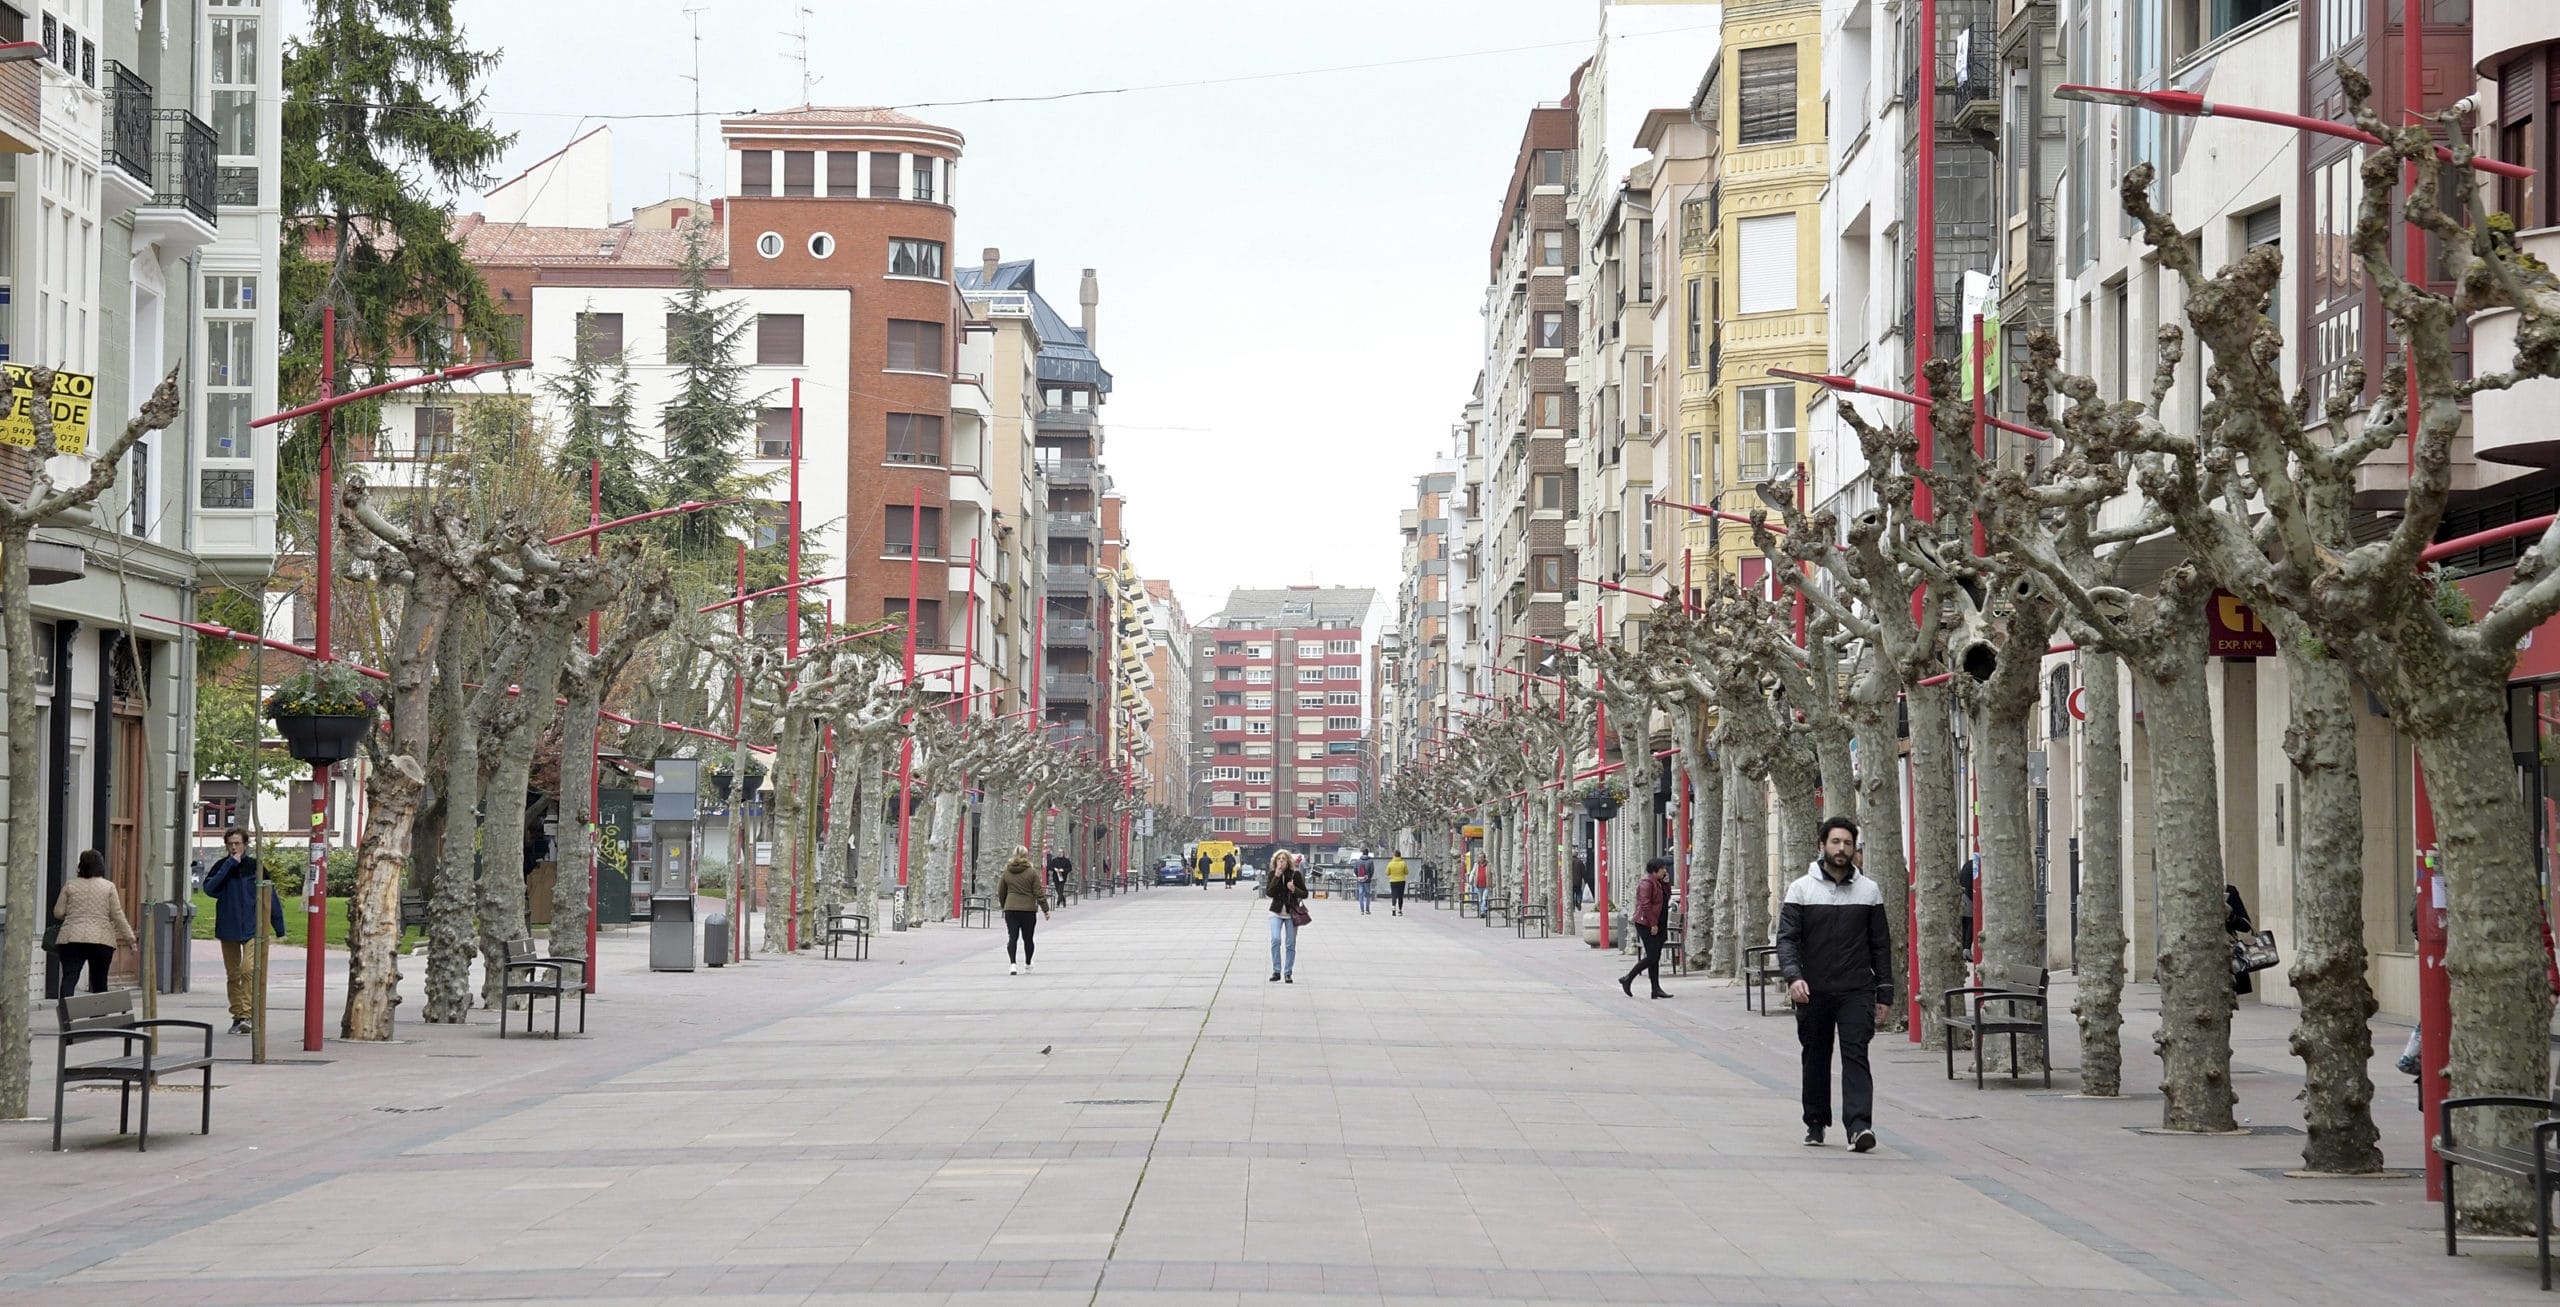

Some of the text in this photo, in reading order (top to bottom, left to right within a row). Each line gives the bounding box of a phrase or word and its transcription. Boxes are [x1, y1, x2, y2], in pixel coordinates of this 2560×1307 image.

[13, 395, 87, 425] EDE
[10, 436, 79, 454] 947 452
[2218, 640, 2240, 650] EXP.
